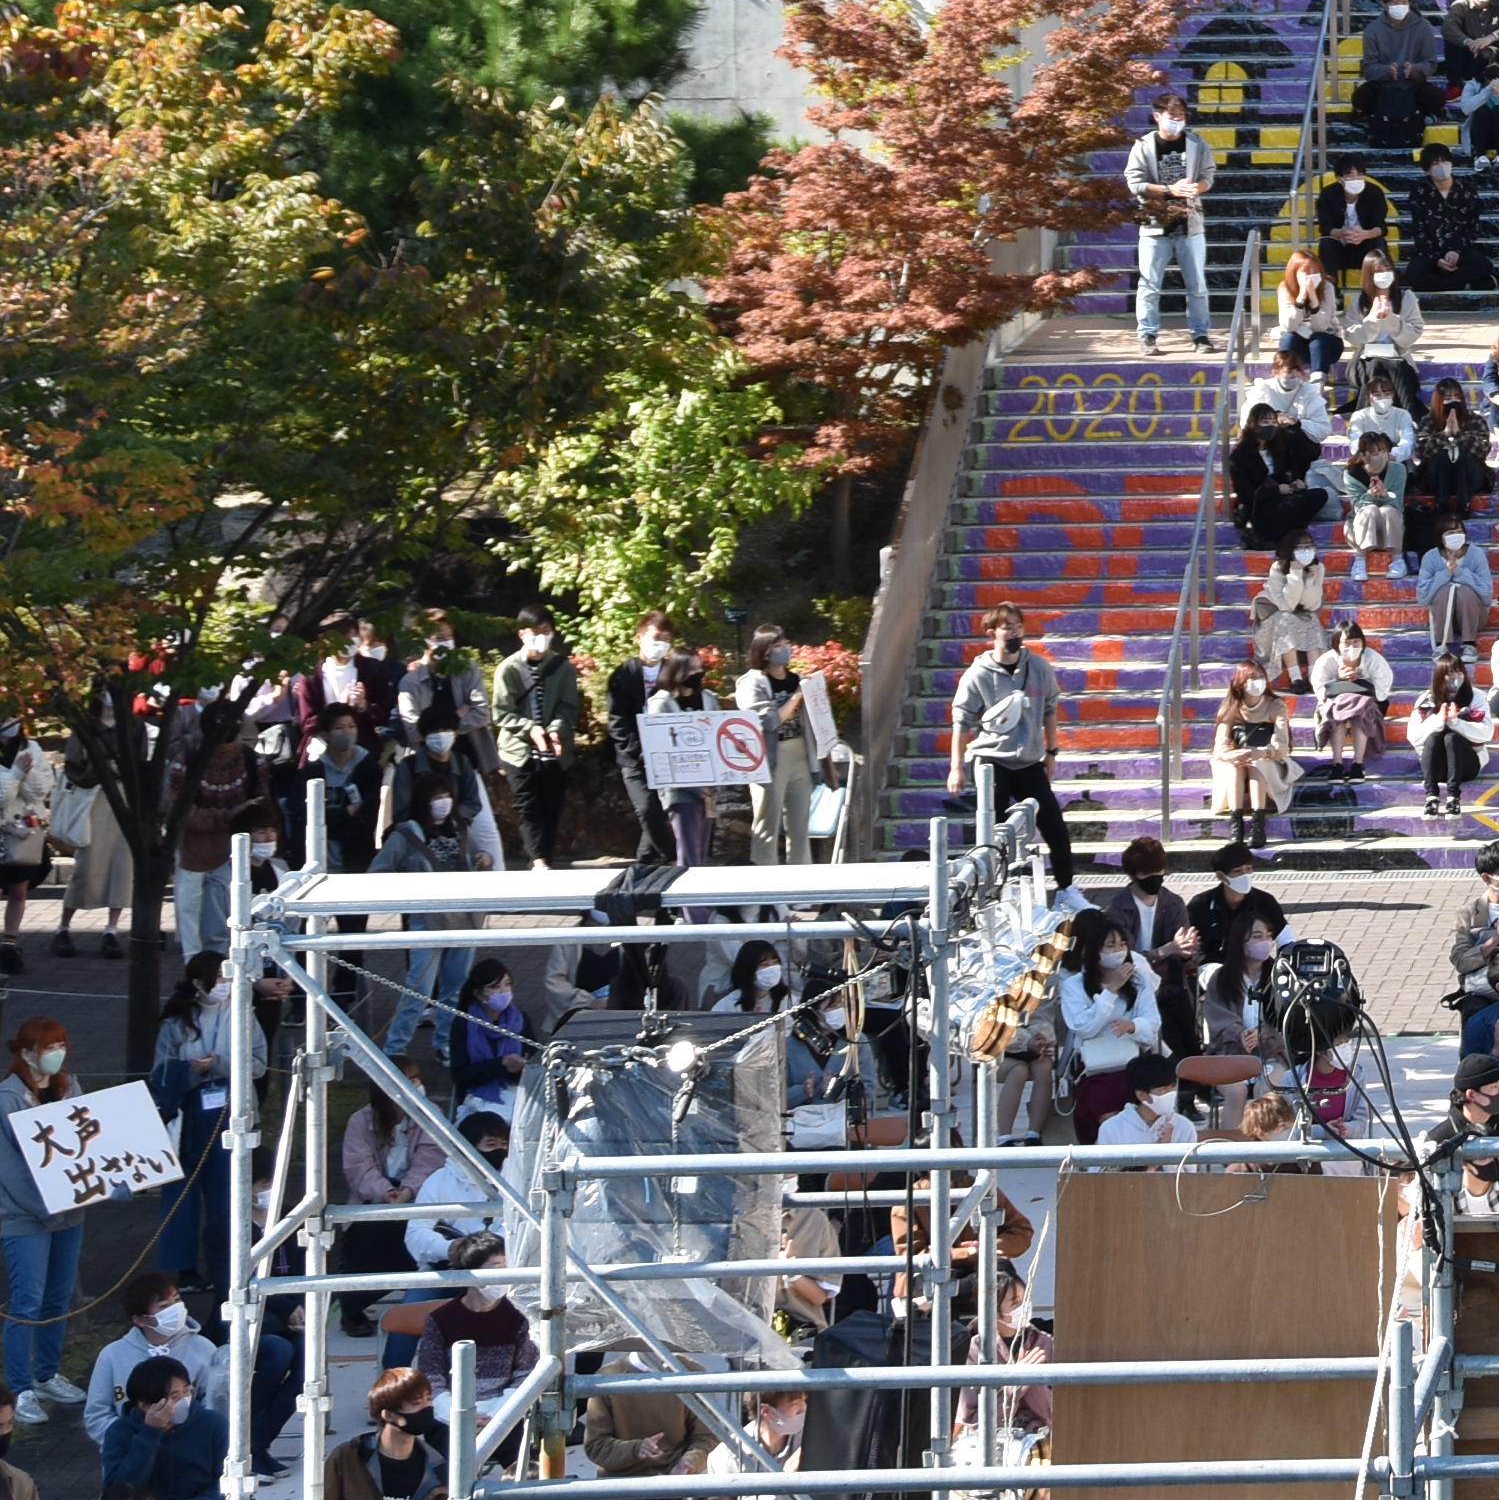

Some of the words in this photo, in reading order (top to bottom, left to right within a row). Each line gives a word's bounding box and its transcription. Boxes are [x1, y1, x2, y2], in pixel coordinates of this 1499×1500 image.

[31, 1105, 101, 1168] 大声
[64, 1149, 176, 1205] 出さない
